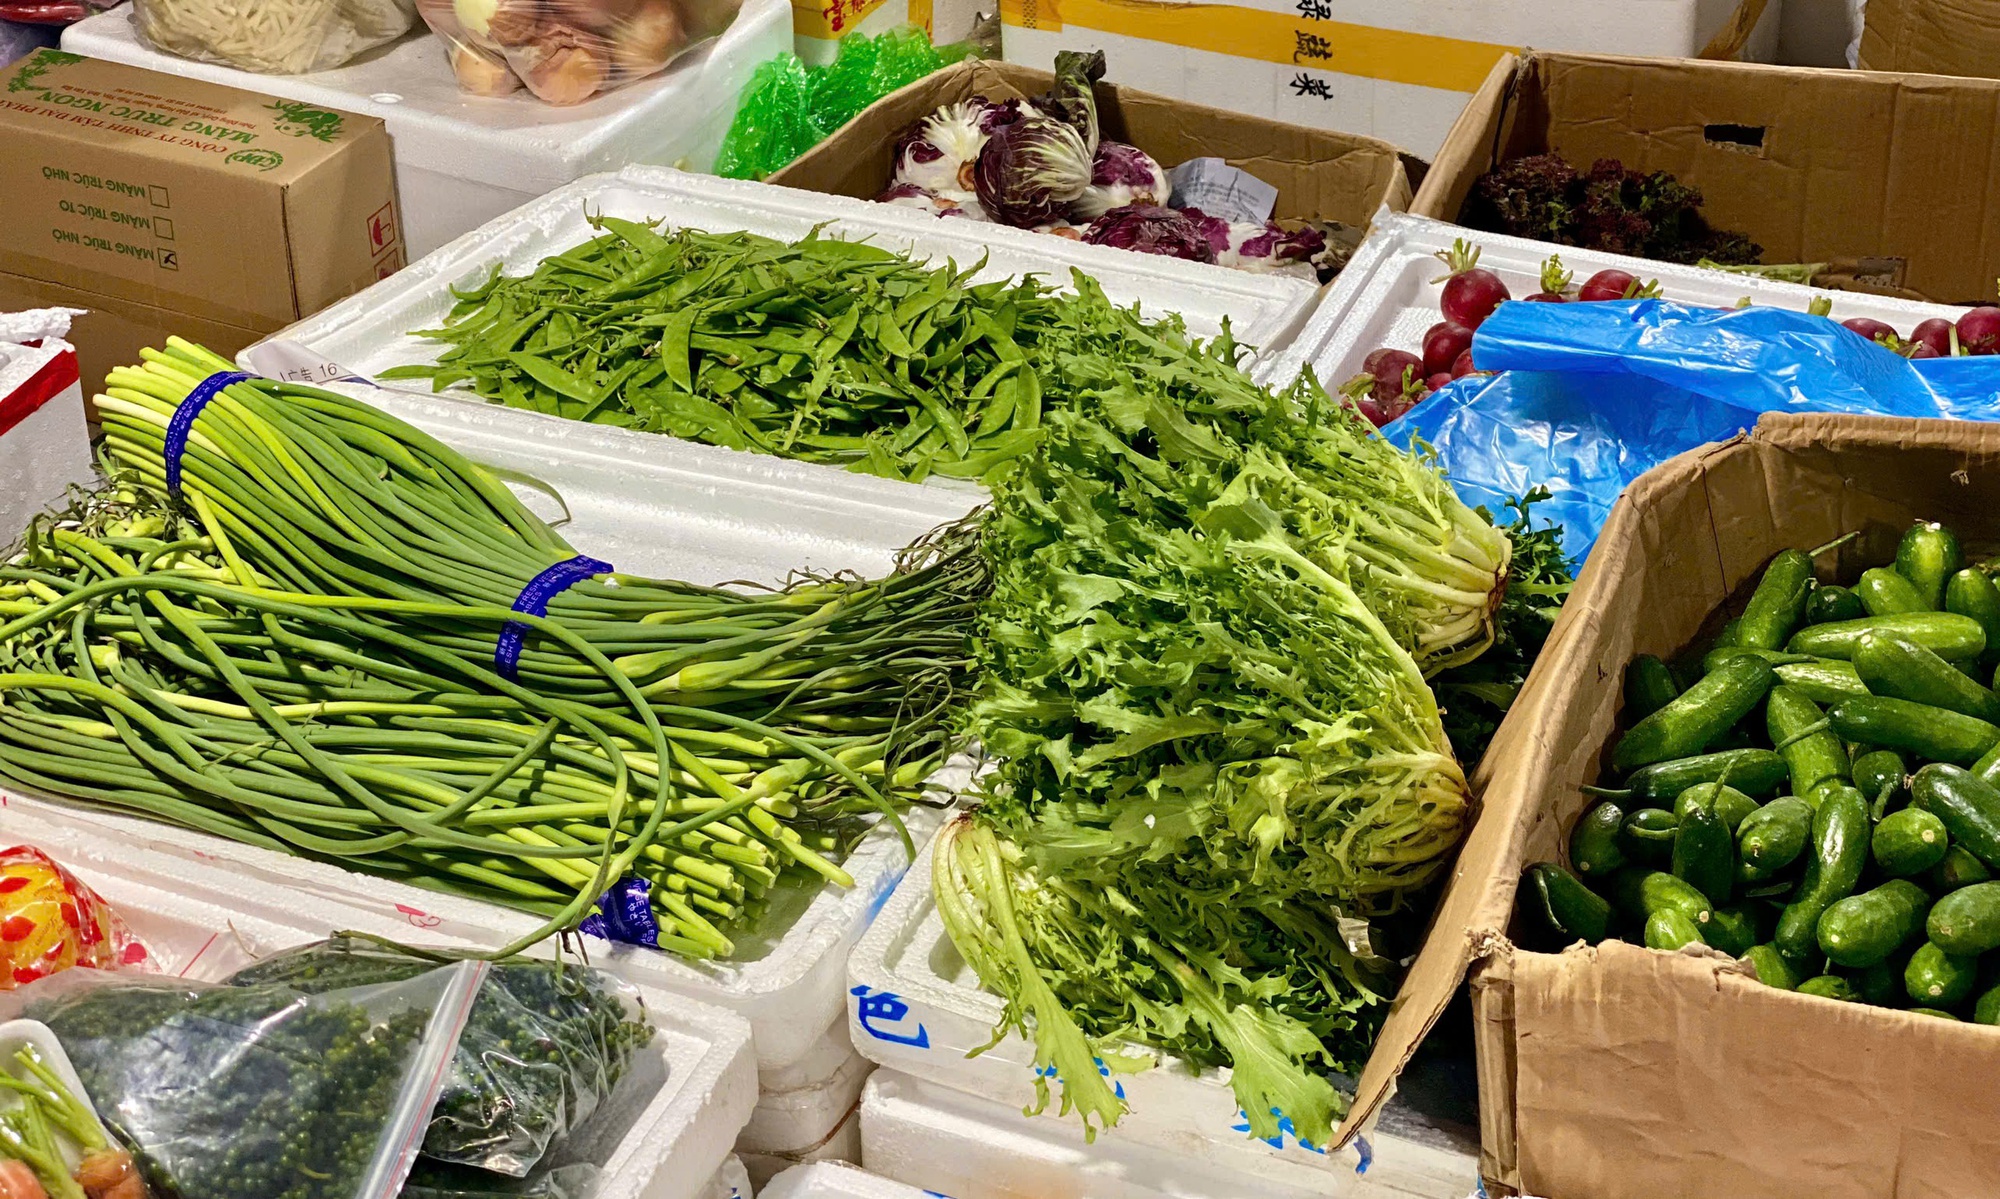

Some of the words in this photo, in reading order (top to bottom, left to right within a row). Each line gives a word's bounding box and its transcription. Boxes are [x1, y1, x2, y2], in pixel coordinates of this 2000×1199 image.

[36, 91, 111, 113] NGON
[109, 106, 178, 127] TRÚC
[106, 123, 154, 137] TNHH
[153, 133, 177, 143] TY
[180, 138, 228, 153] CÔNG
[72, 172, 104, 189] TRÚC
[59, 199, 76, 214] TO
[78, 203, 108, 220] TRÚC
[83, 235, 113, 251] TRÚC
[319, 362, 337, 378] 16
[519, 582, 541, 606] FRESH
[849, 985, 930, 1049] 色
